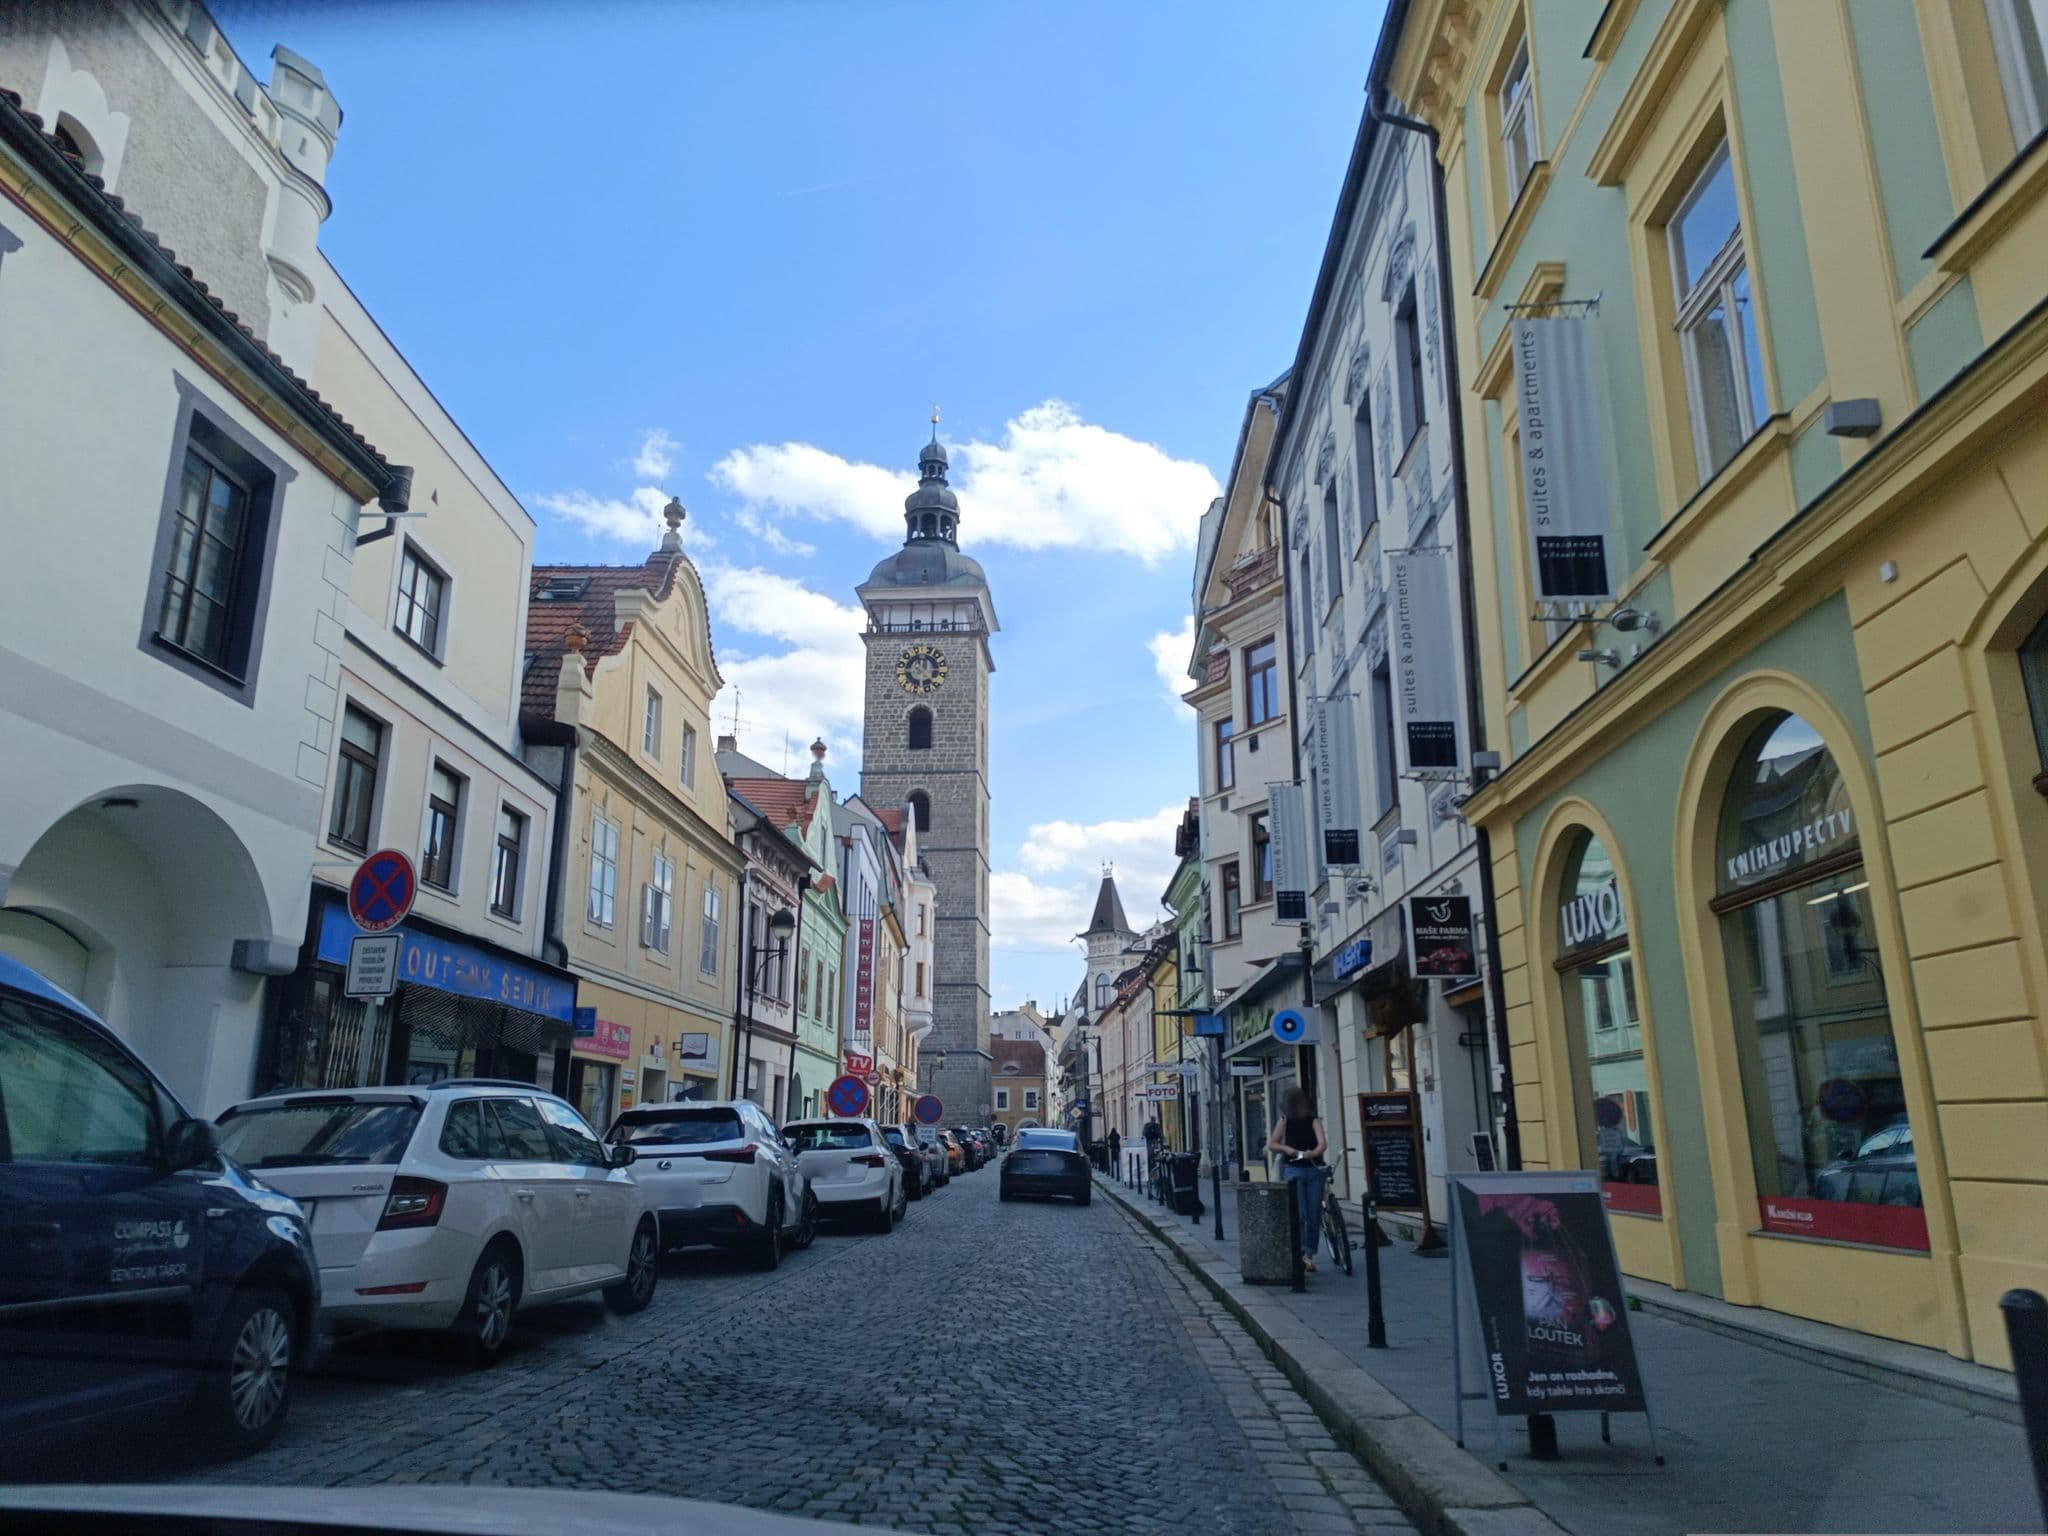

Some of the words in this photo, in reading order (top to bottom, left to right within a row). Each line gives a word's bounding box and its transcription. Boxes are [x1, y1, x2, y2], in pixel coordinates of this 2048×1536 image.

[1521, 330, 1545, 440] apartments
[1529, 447, 1544, 459] &
[1531, 466, 1550, 526] suites
[1396, 564, 1414, 649] apartments
[1401, 653, 1414, 664] &
[1403, 669, 1418, 715] suites
[1318, 708, 1331, 775] apartments
[1271, 792, 1281, 846] apartments
[1324, 799, 1333, 824] suites
[1728, 808, 1850, 880] KNIHKUPECTV
[850, 1056, 869, 1069] TV
[1148, 1088, 1176, 1097] FOTO
[1528, 1327, 1584, 1347] LOUTEK
[1491, 1353, 1510, 1400] LUXOR
